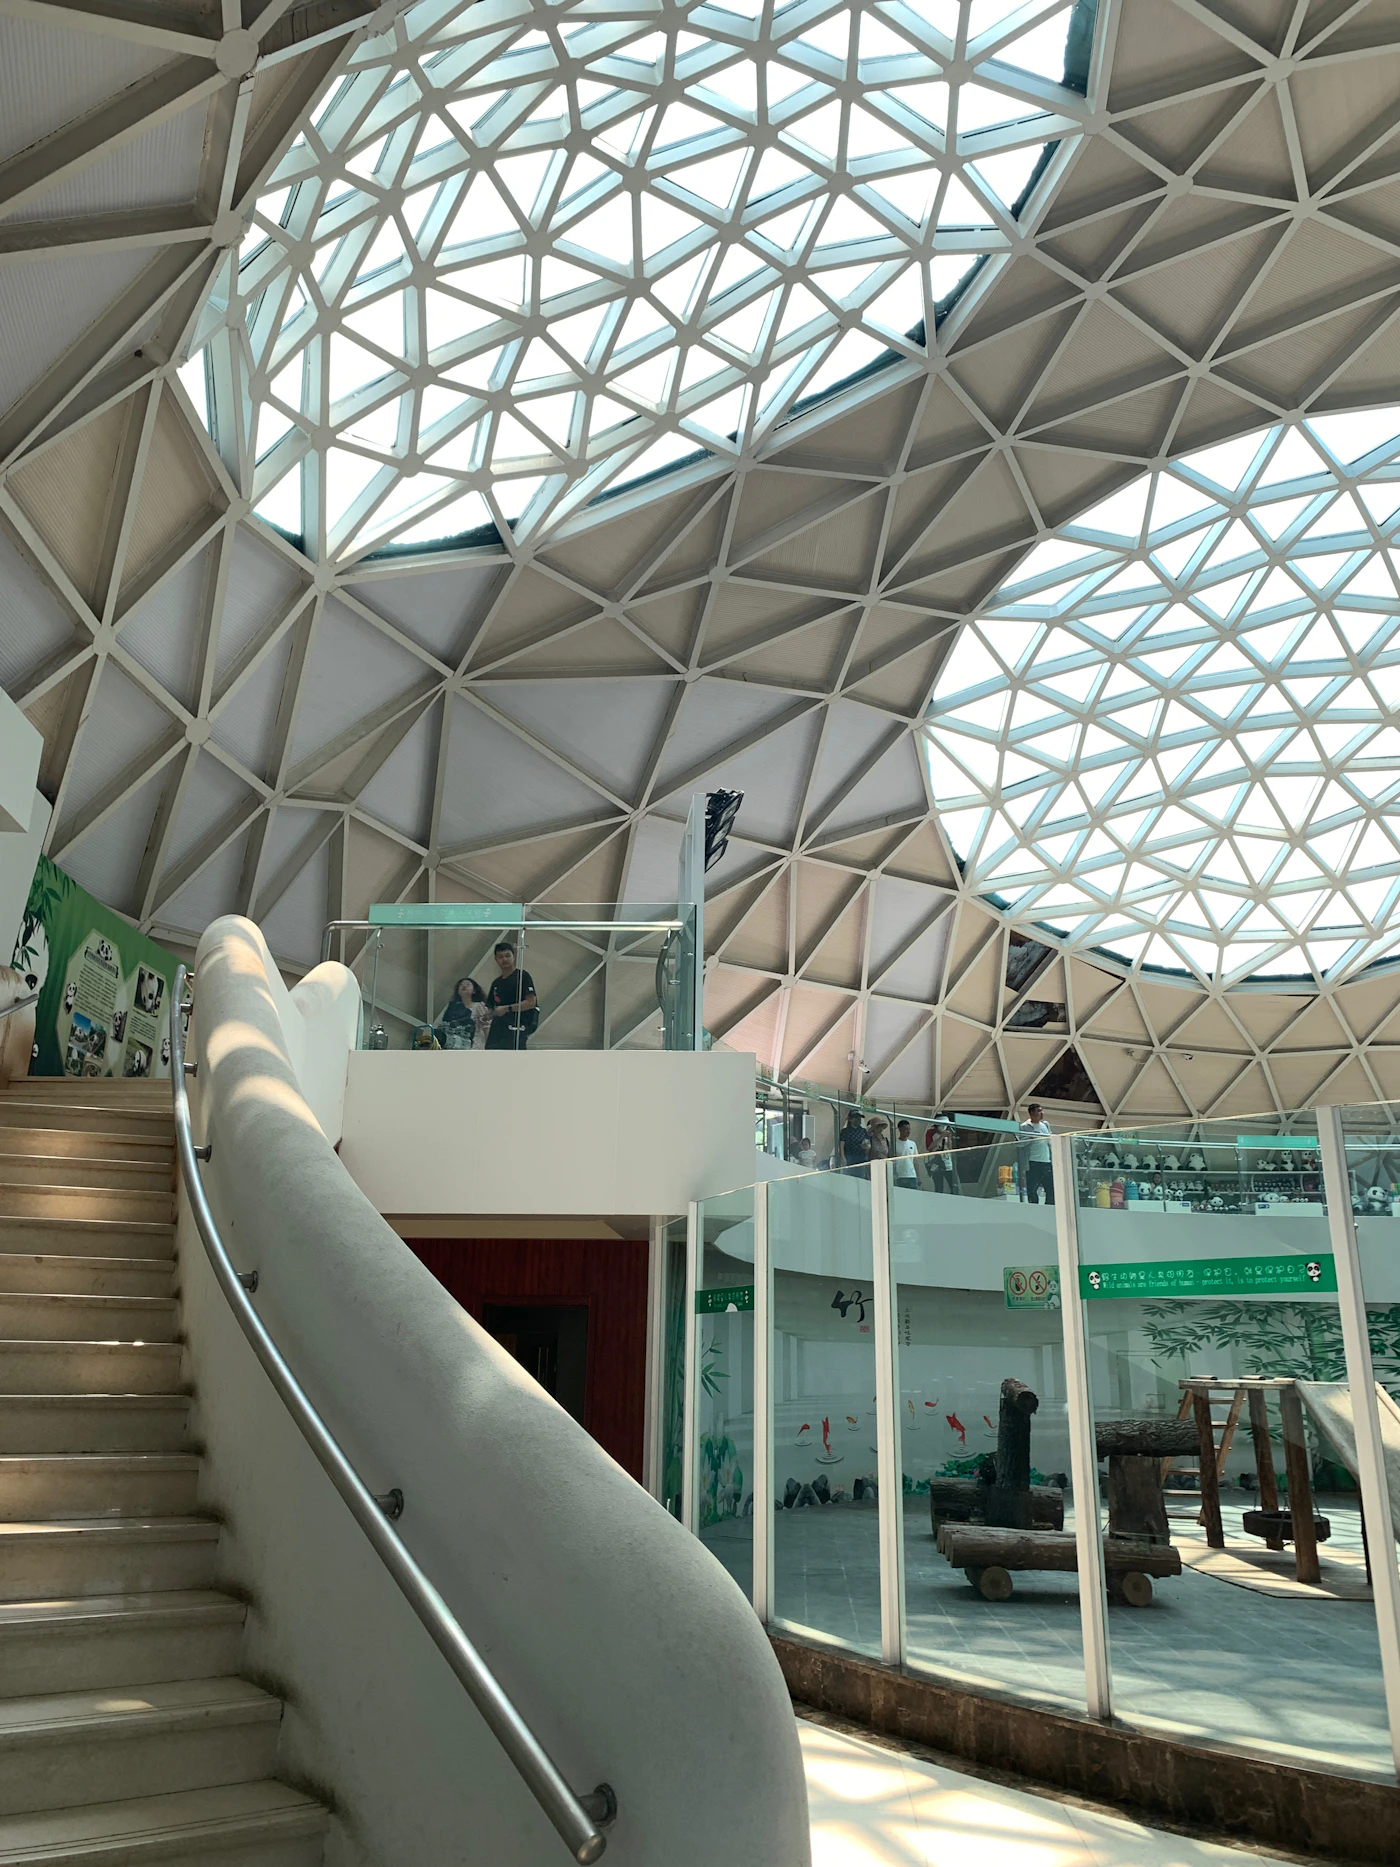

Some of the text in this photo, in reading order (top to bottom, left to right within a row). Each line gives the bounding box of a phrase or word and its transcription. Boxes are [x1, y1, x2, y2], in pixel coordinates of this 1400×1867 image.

[1103, 1281, 1115, 1289] Wild
[1148, 1280, 1169, 1288] friends
[1170, 1279, 1177, 1287] of
[1202, 1278, 1223, 1287] protect
[1237, 1276, 1244, 1284] is
[1255, 1276, 1278, 1285] protect
[1280, 1274, 1306, 1284] yourself
